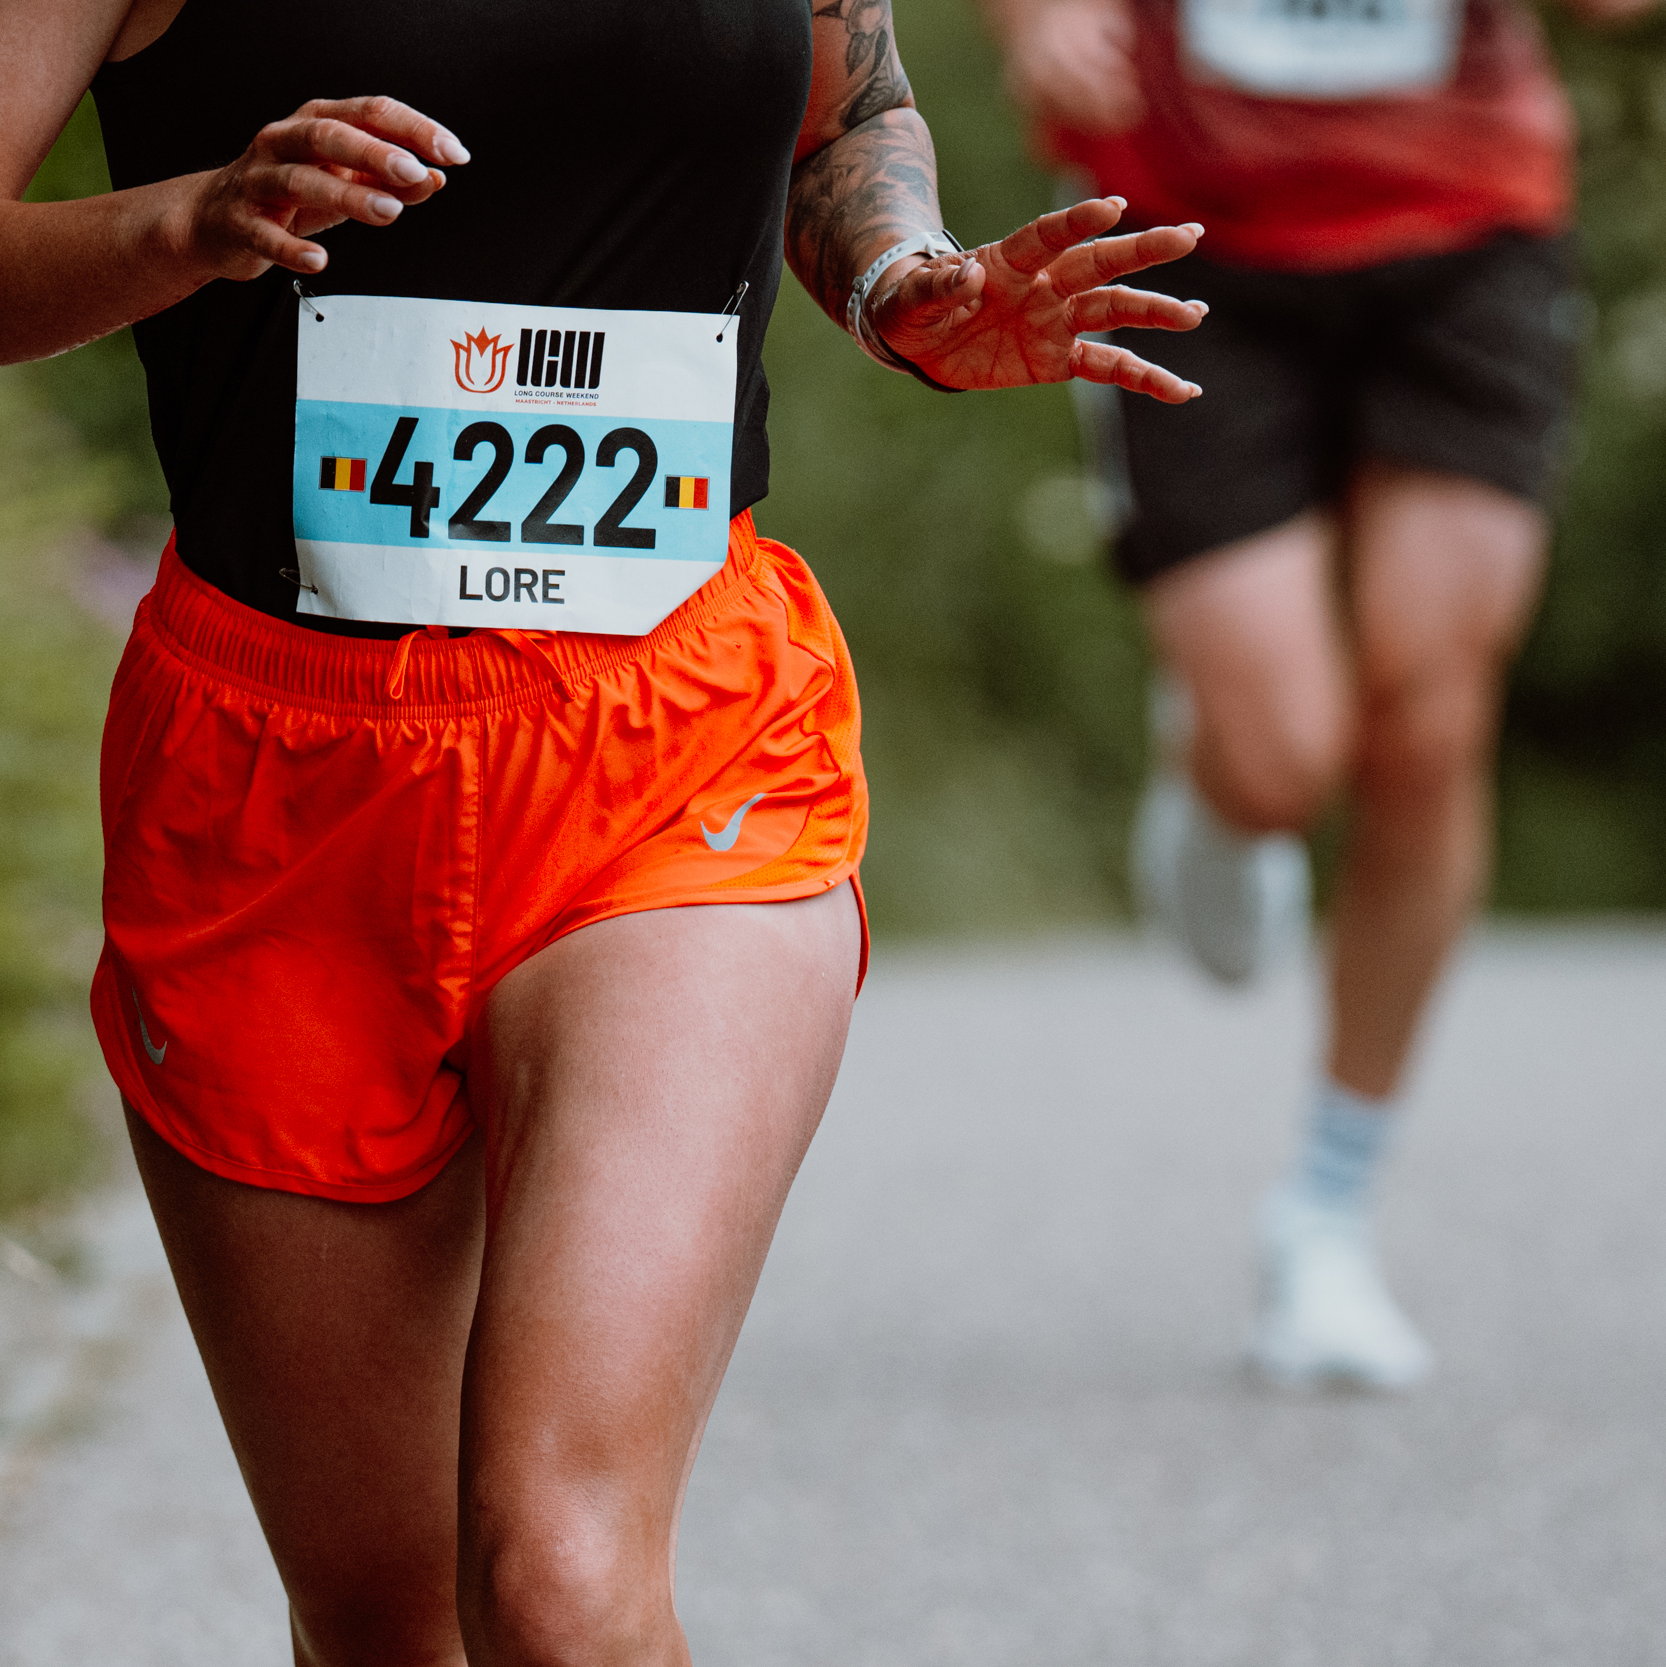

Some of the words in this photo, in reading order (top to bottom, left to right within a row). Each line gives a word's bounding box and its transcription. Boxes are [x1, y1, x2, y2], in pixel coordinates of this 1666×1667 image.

[535, 390, 564, 398] COURSE
[369, 416, 659, 550] 4222
[459, 565, 566, 605] LORE
